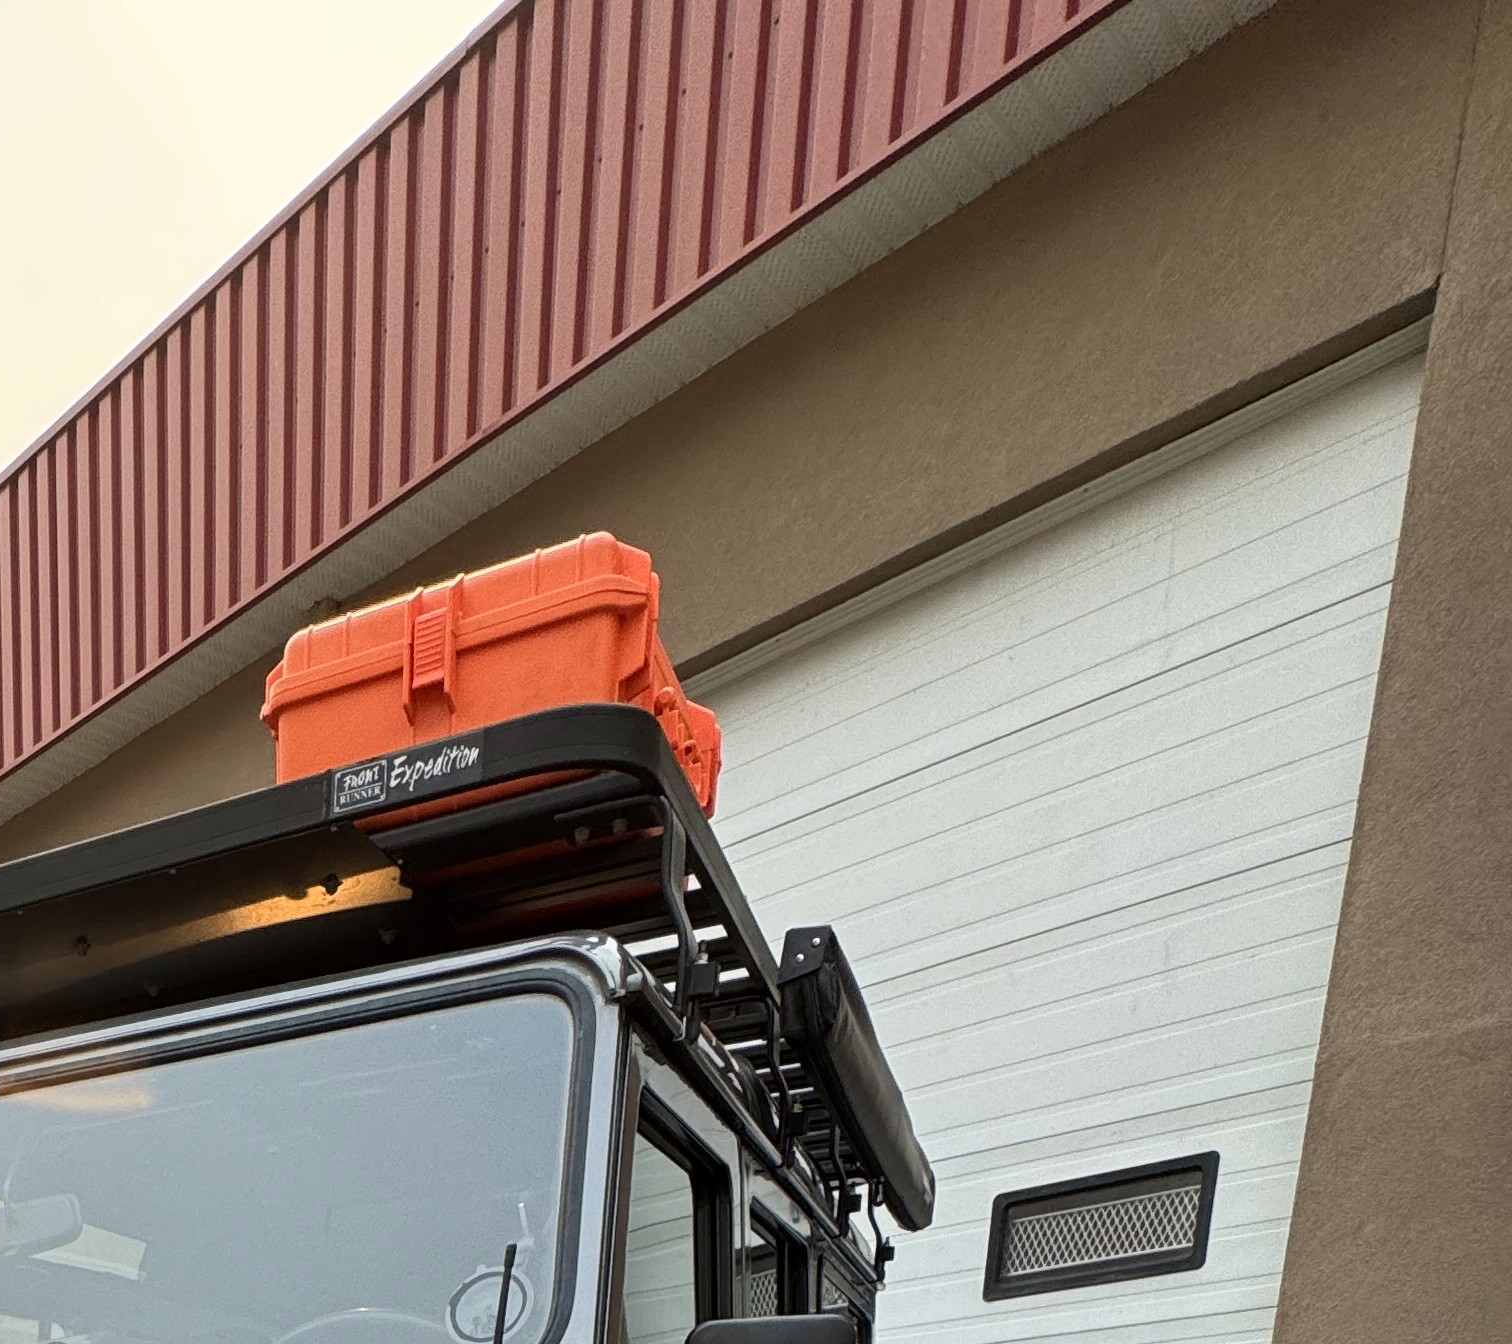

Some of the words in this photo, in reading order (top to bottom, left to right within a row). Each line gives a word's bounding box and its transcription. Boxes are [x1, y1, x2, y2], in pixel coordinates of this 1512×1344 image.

[343, 765, 380, 791] FRONT
[389, 745, 480, 792] Expedition
[340, 785, 381, 805] RUNNER
